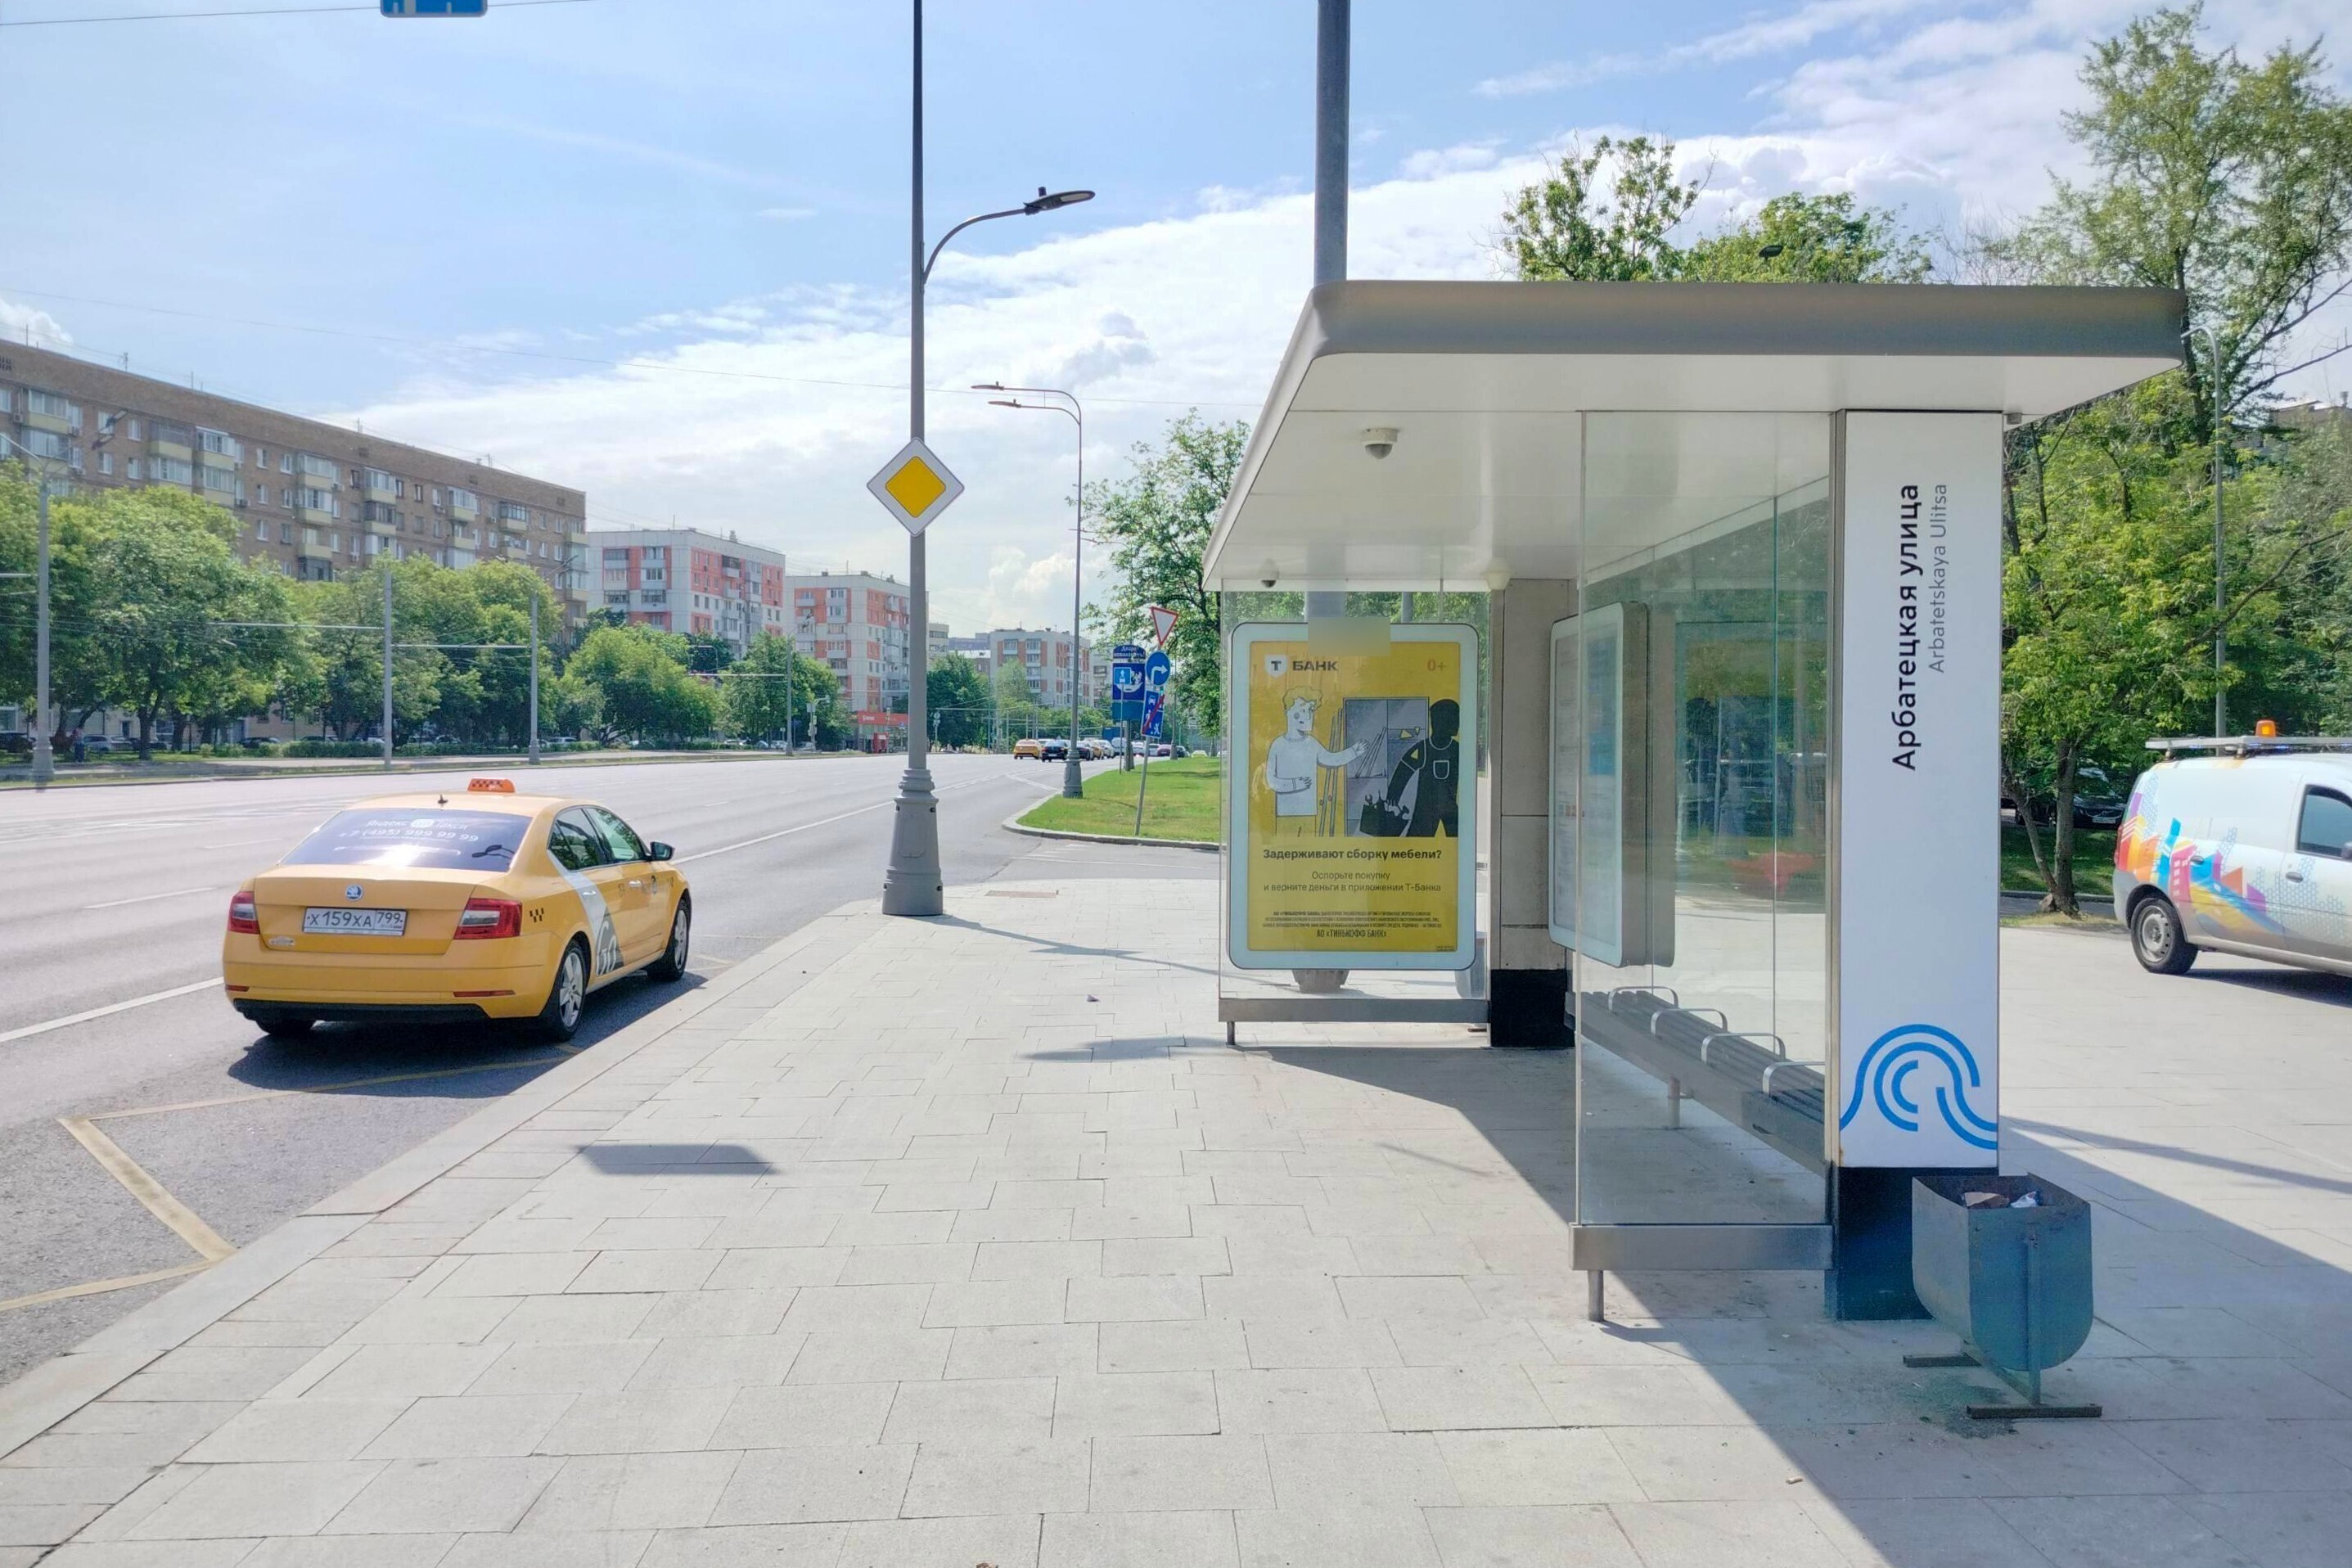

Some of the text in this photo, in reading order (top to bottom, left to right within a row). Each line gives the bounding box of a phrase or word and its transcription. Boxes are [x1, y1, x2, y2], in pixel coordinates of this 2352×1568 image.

[1928, 484, 1949, 674] Arbatetskaya Ulitsa
[1891, 484, 1923, 771] Арбатецкая улица
[1292, 660, 1338, 671] БАНК
[1427, 660, 1446, 671] 0+
[459, 833, 479, 841] 99
[1264, 849, 1442, 861] Задерживают сборку мебели?
[1312, 871, 1390, 881] Оспорьте покупку
[1309, 885, 1340, 893] деньги
[1349, 884, 1404, 893] приложении
[1405, 884, 1441, 892] Т-Банка
[377, 912, 401, 924] 799
[1316, 929, 1386, 938] АО «ТИНЬКОФФ БАНК»
